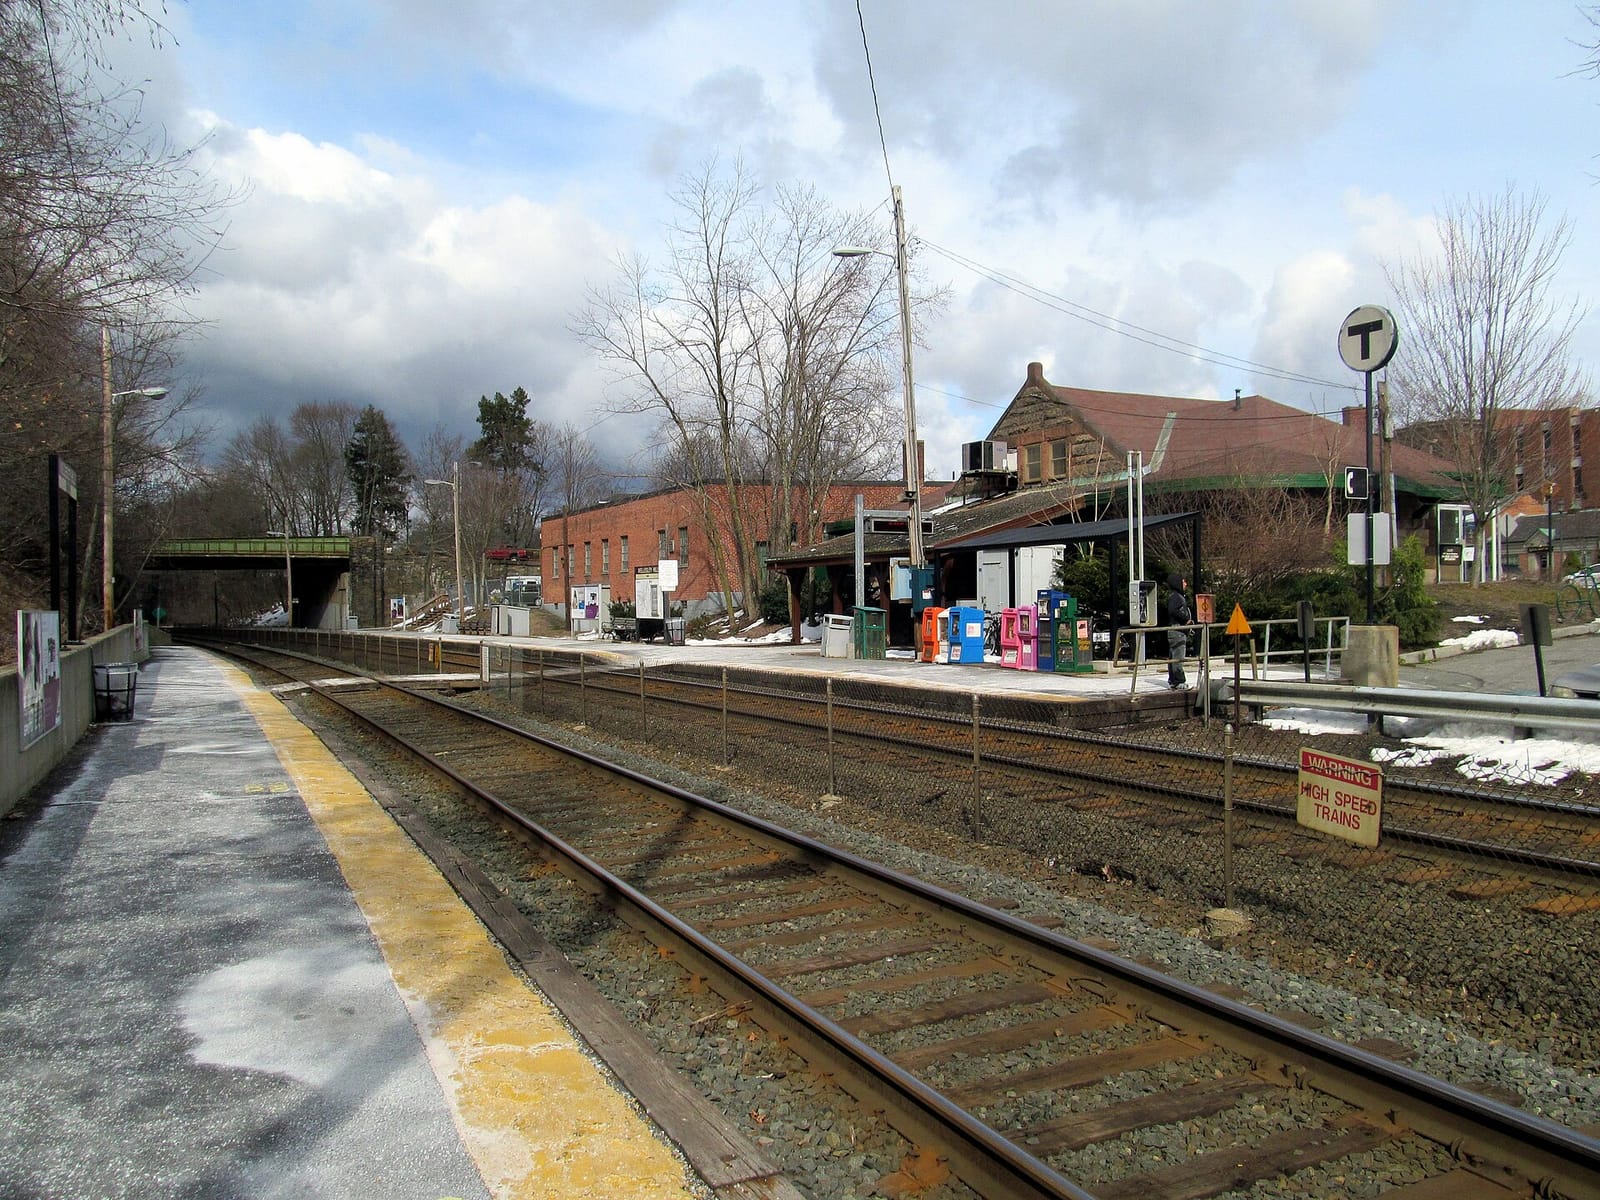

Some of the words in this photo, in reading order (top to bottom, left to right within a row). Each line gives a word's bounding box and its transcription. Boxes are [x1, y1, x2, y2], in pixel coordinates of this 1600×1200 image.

[1348, 320, 1383, 360] T
[1309, 755, 1371, 785] WARNING
[1300, 781, 1329, 802] HIGH
[1335, 791, 1377, 815] SPEED
[1314, 803, 1360, 830] TRAINS
